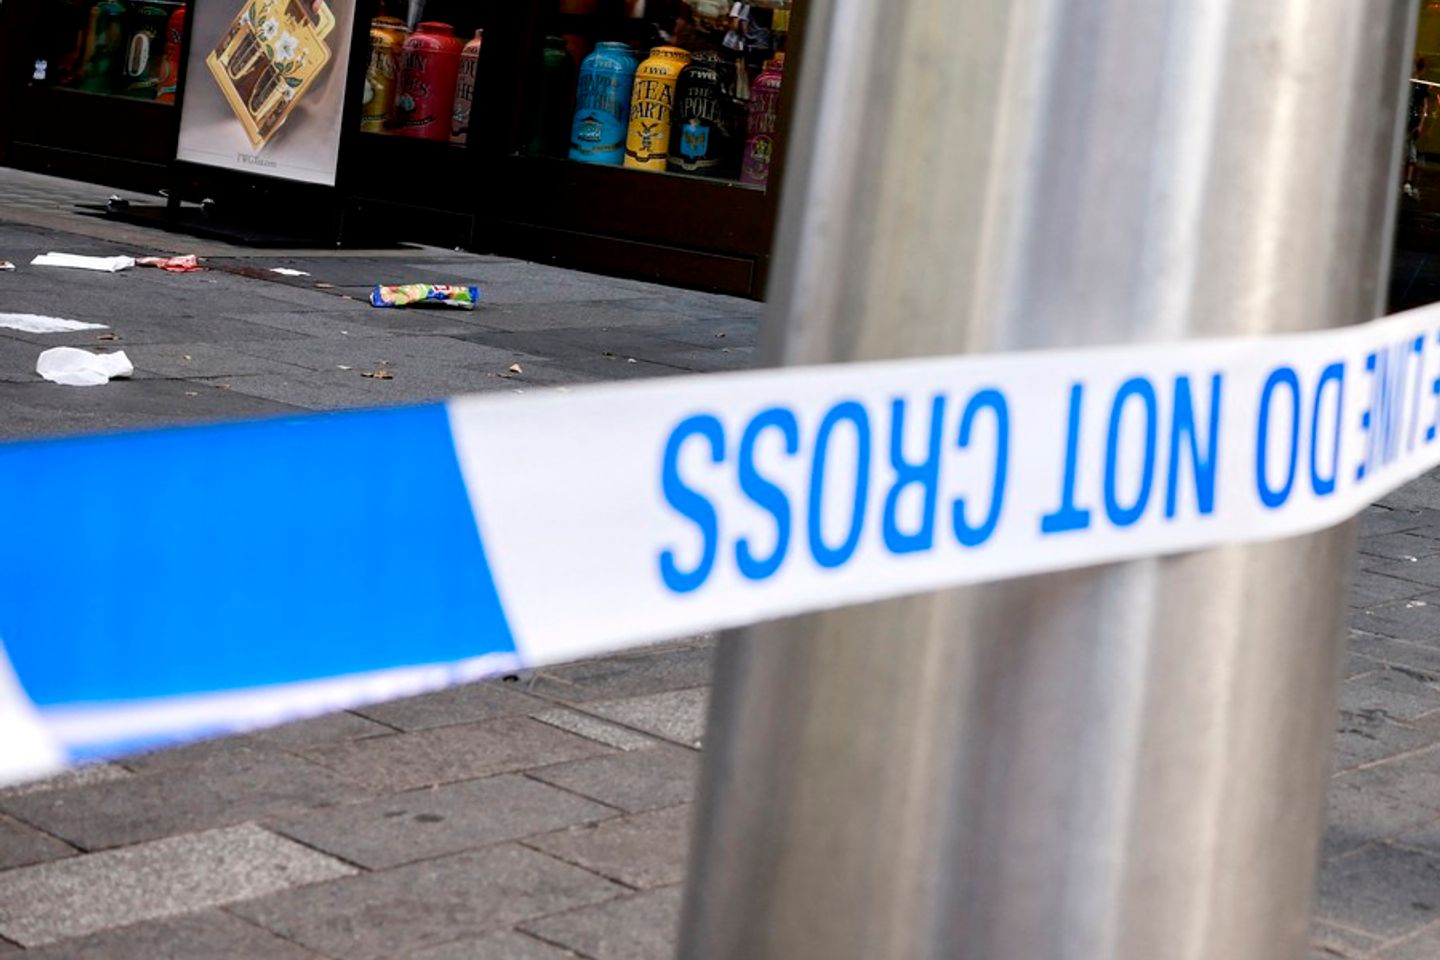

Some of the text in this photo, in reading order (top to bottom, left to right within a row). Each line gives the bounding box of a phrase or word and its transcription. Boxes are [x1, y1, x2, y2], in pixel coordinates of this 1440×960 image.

[632, 80, 674, 105] TEA
[1040, 370, 1223, 534] NOT
[1256, 360, 1345, 510] DO
[1354, 334, 1424, 482] LINE
[658, 387, 1010, 594] CROSS
